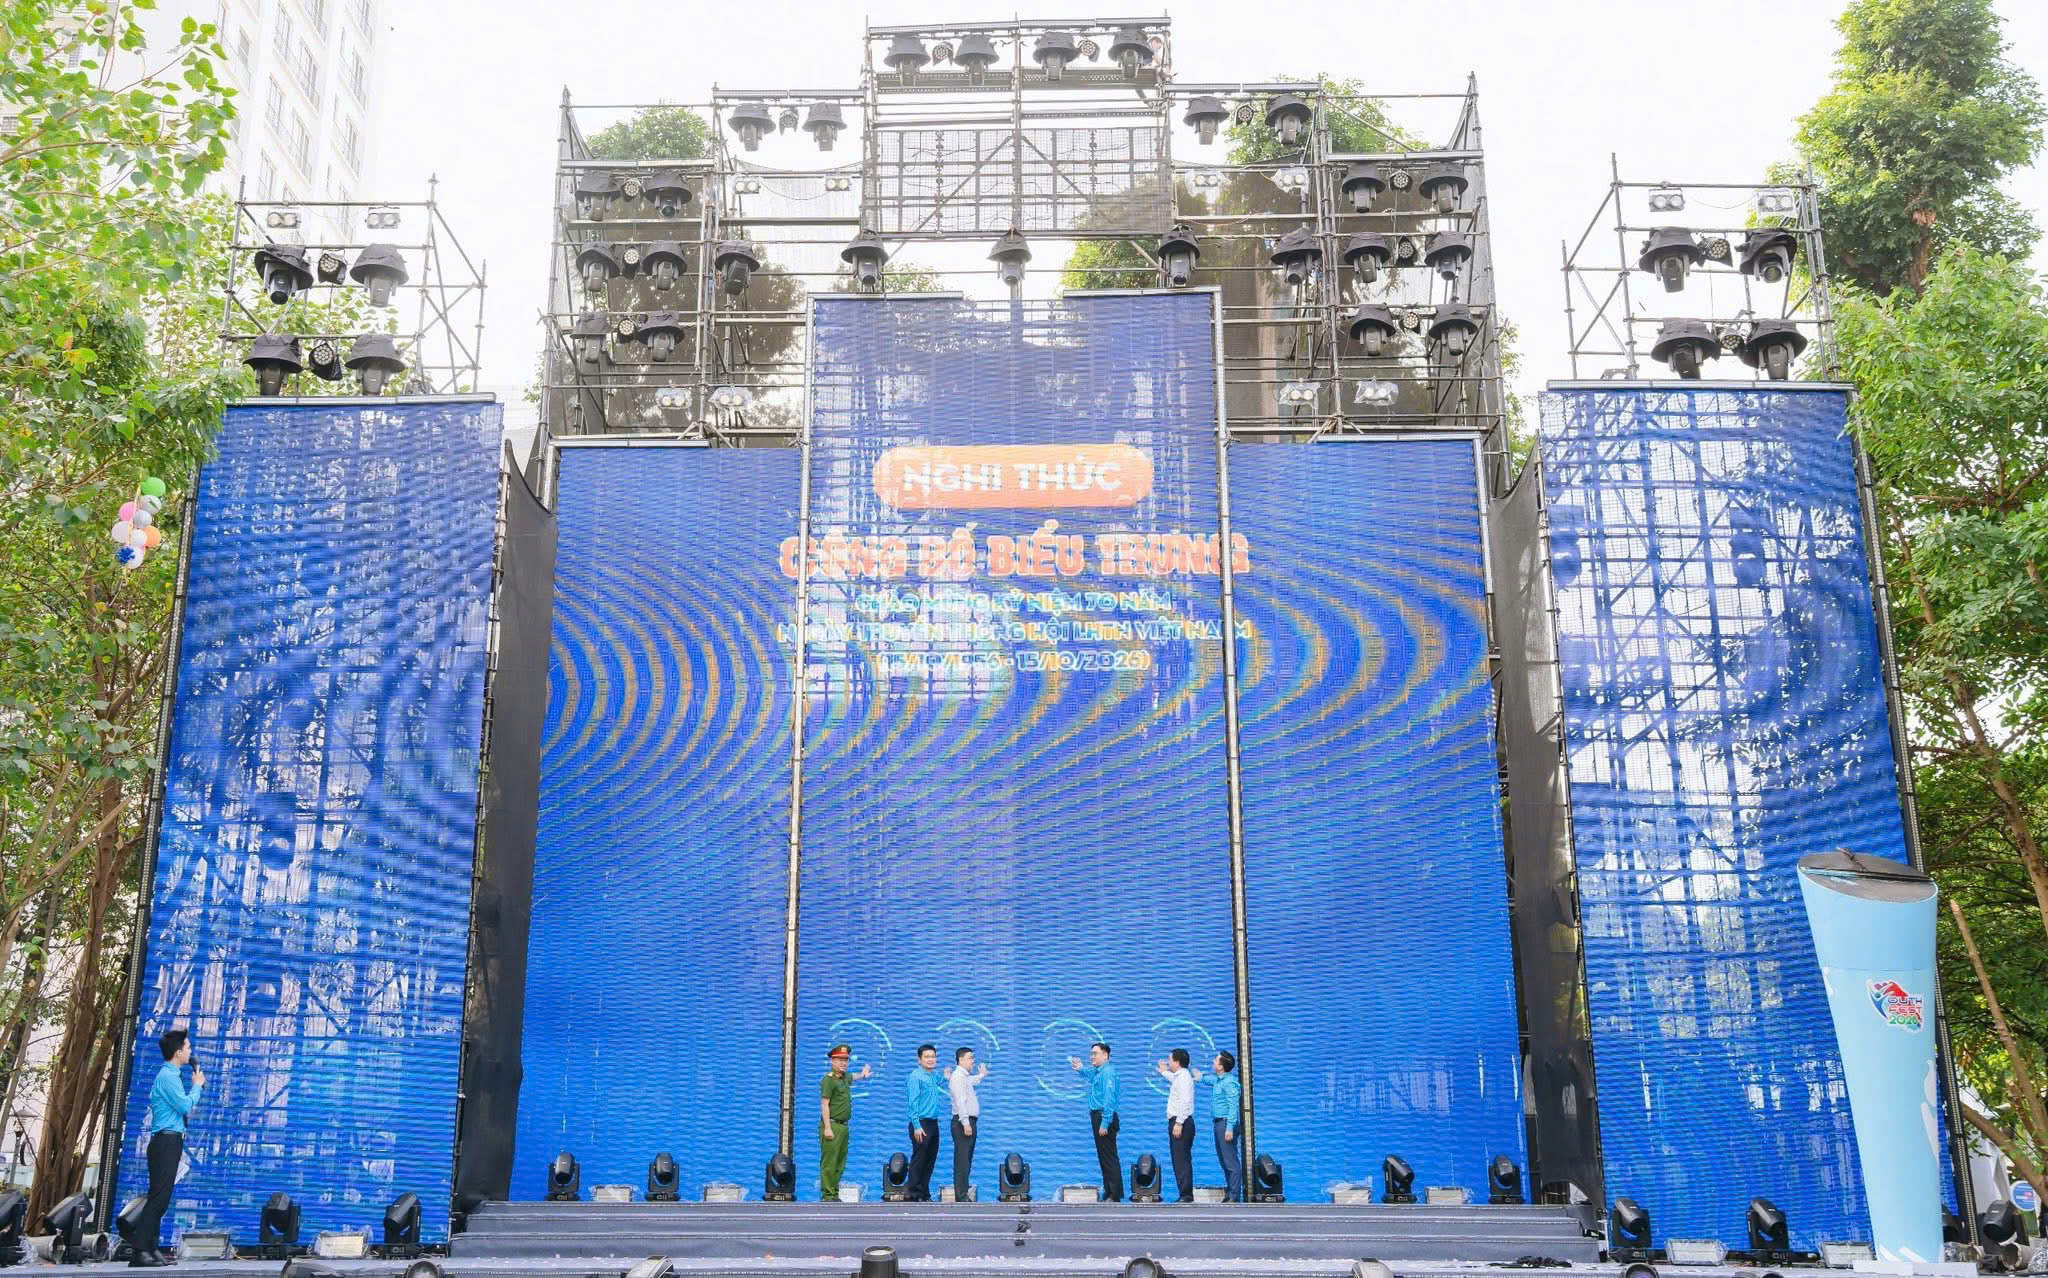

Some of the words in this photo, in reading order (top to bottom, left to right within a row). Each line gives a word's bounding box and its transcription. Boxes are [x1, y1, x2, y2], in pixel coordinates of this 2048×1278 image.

[903, 463, 1001, 492] NGHI
[1012, 453, 1122, 491] THỨC
[917, 521, 976, 577] BỐ
[986, 519, 1085, 576] BIỂU
[1120, 587, 1172, 611] NĂM
[1027, 617, 1069, 644] HỘI
[1133, 616, 1183, 643] VIỆT
